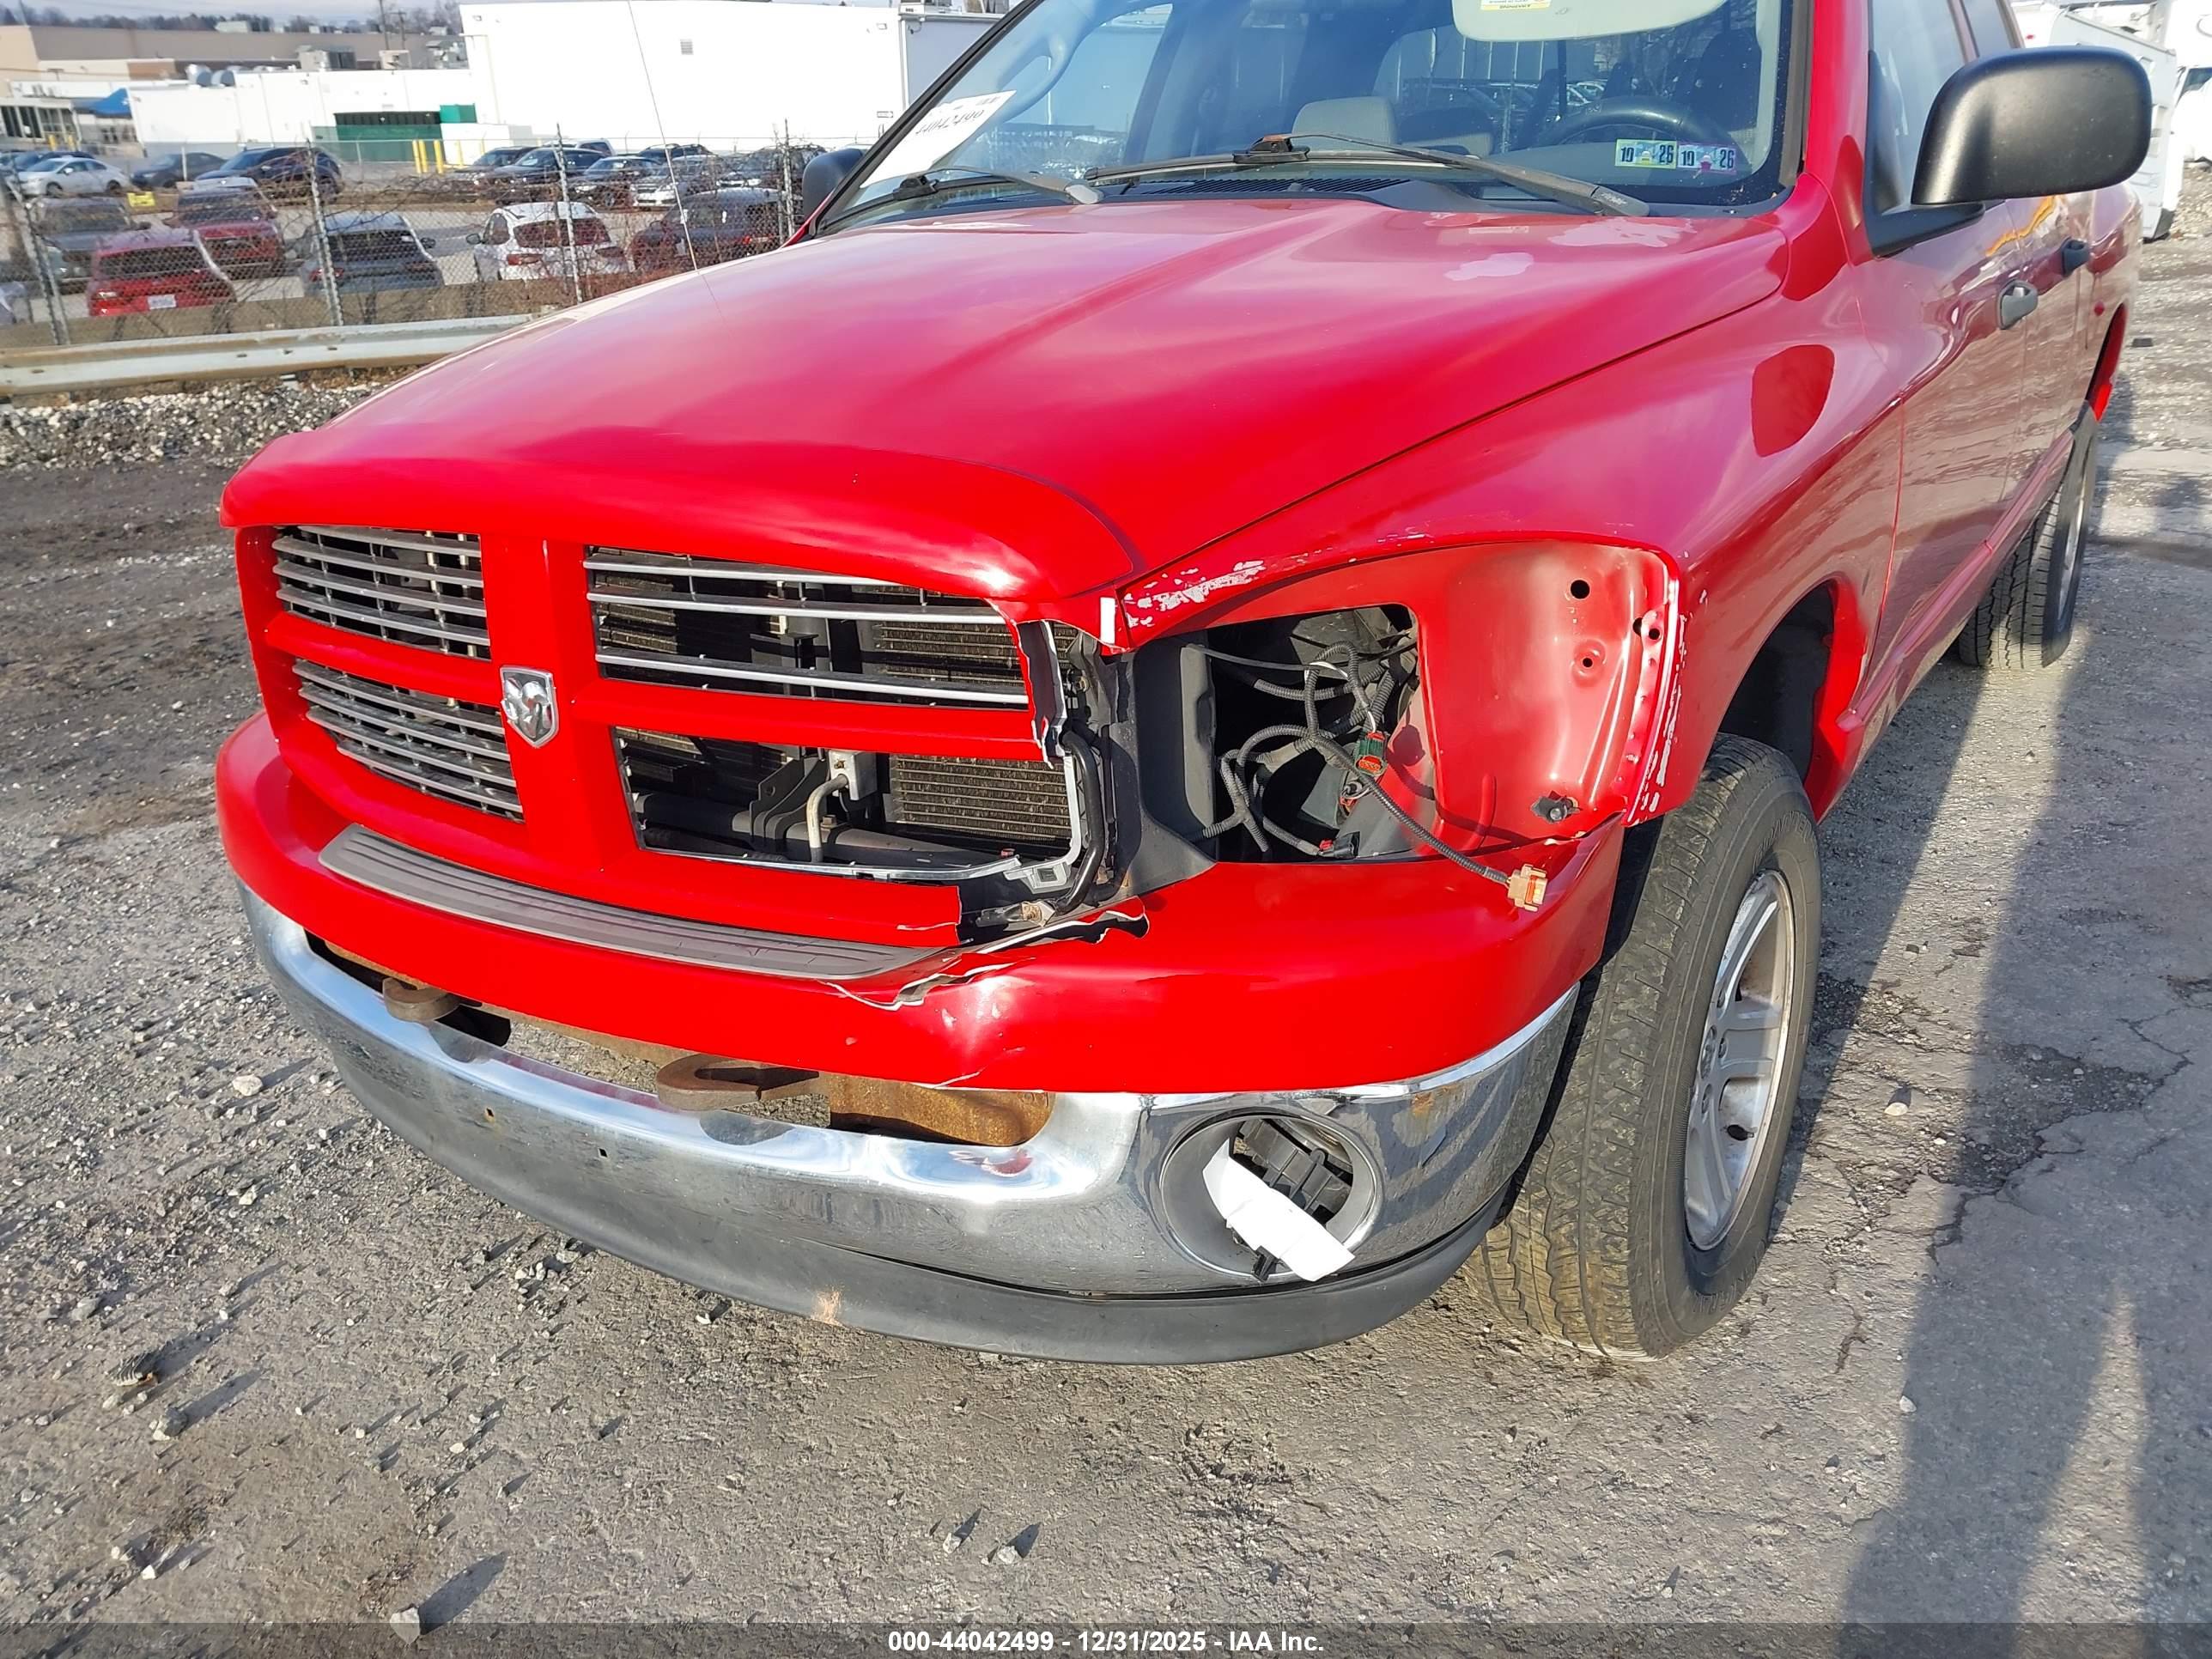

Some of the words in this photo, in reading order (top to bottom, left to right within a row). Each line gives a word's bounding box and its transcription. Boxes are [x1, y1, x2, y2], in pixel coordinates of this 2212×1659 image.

[1620, 147, 1635, 163] 10
[1659, 144, 1674, 163] 26
[1681, 150, 1695, 167] 10
[1719, 149, 1735, 168] 26
